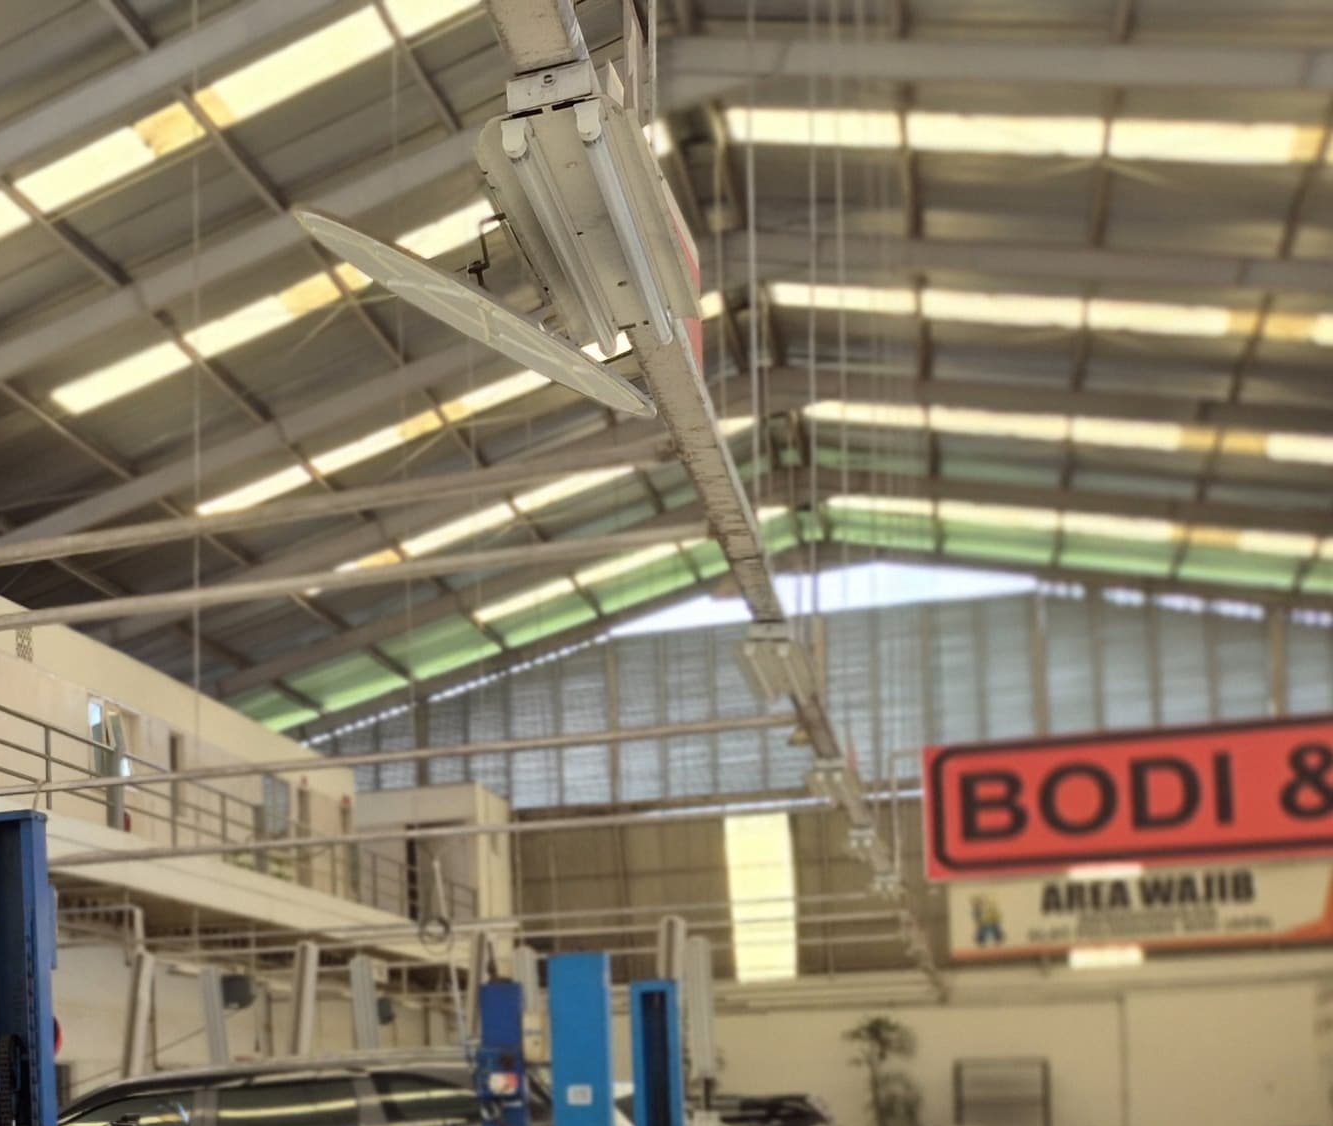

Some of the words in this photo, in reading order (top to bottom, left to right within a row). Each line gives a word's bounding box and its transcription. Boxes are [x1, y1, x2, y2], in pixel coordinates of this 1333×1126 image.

[959, 750, 1236, 843] BODI
[1279, 743, 1333, 822] &
[1041, 878, 1131, 915] AREA
[1139, 867, 1256, 907] WAJIB
